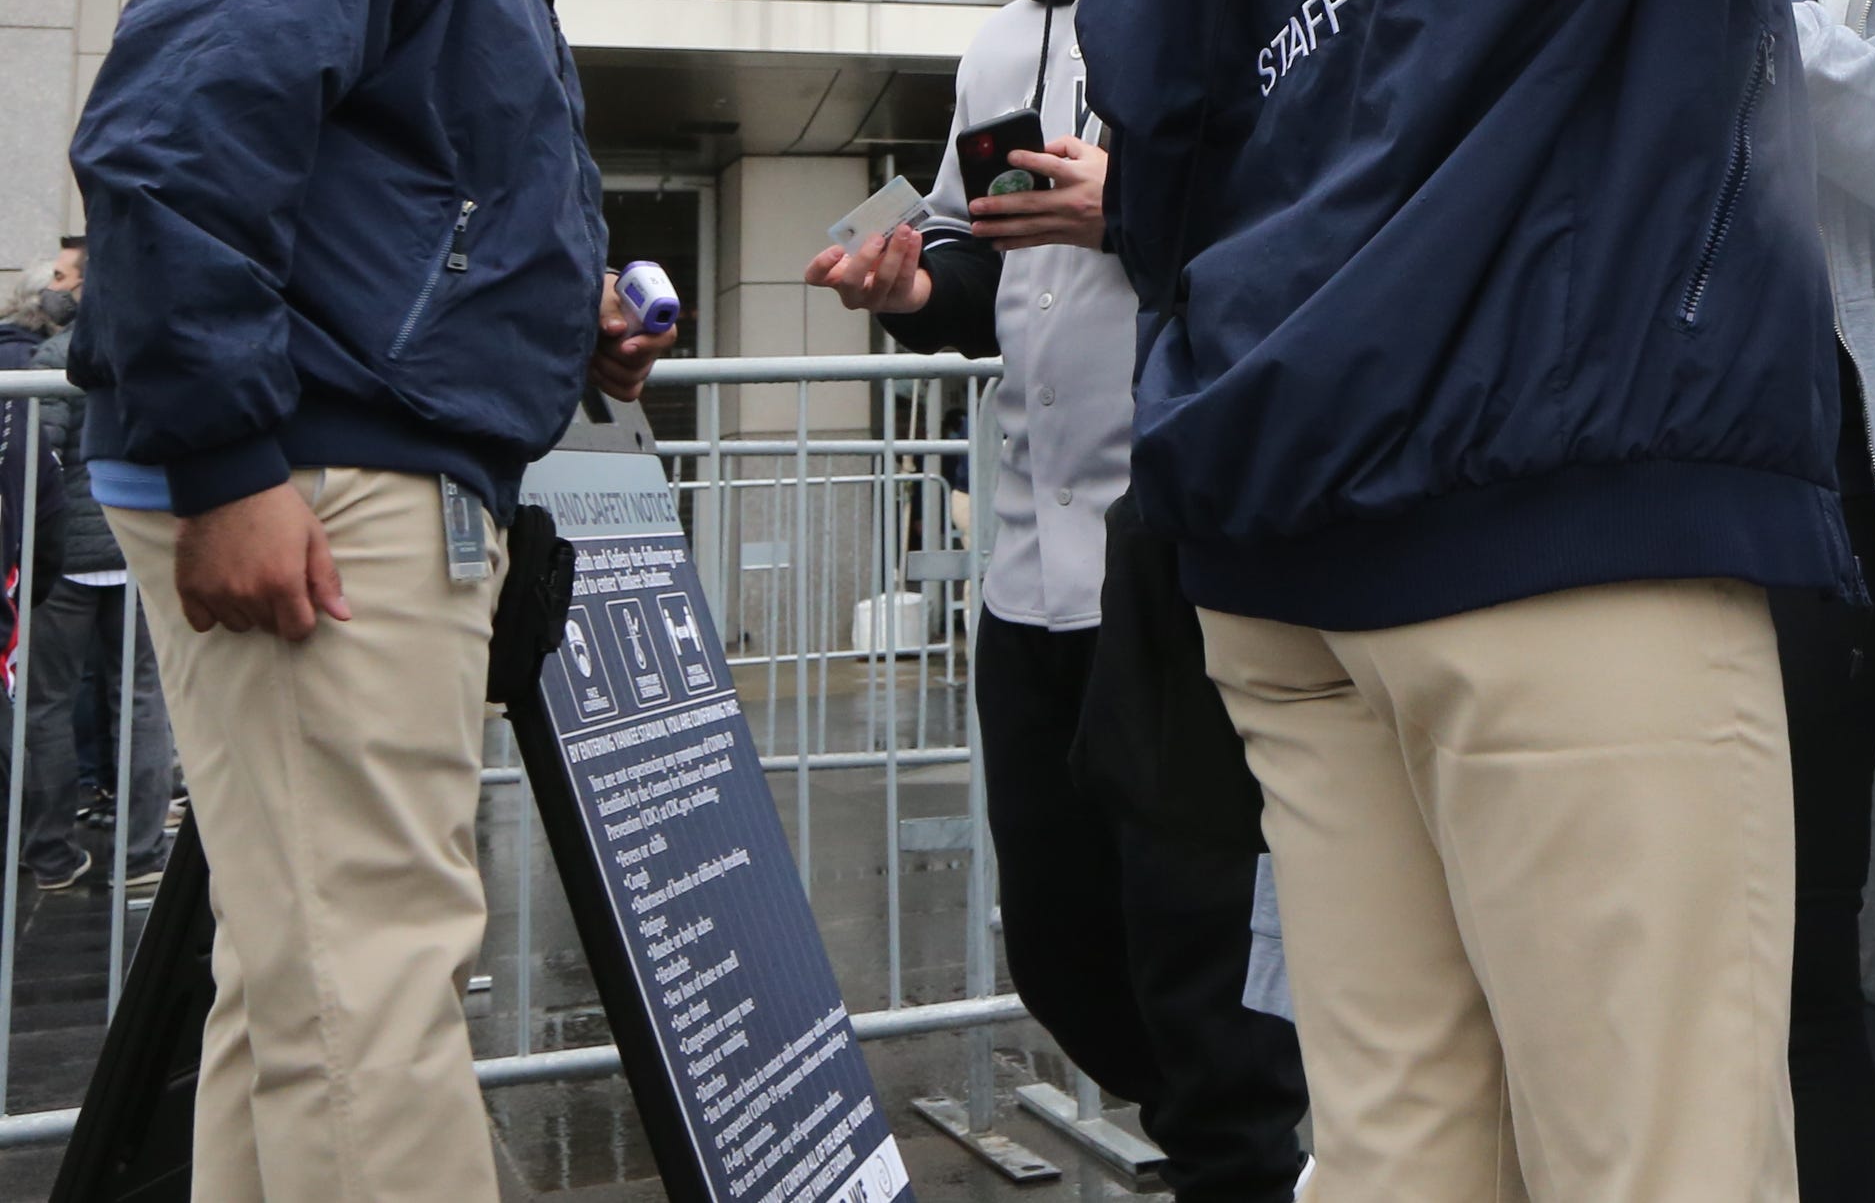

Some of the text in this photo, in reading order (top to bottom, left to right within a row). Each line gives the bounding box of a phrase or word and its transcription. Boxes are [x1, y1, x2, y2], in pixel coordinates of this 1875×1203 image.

[554, 492, 587, 526] AND
[585, 492, 632, 525] SAFETY
[629, 492, 676, 523] NOTICE
[574, 545, 687, 573] ealth and Safety the following are
[596, 575, 618, 593] enter
[614, 568, 643, 591] Yankee
[567, 743, 581, 763] BY
[578, 734, 615, 759] ENTERING
[611, 726, 642, 749] YANKEE
[636, 719, 669, 742] STADIUM,
[664, 715, 683, 733] YOU
[678, 712, 694, 730] ARE
[688, 703, 727, 726] CONFIRMING
[587, 731, 734, 792] You are not experiencing any symptoms of COVID-19
[596, 754, 732, 816] identified by the Centers for Disease Control and
[604, 815, 643, 841] Prevention
[639, 805, 662, 829] (CDC)
[659, 805, 669, 820] at
[640, 844, 650, 858] or
[649, 833, 667, 854] chills
[633, 848, 750, 914] Shortness of breath or difficulty breathing
[641, 915, 668, 937] Fatigue
[648, 916, 713, 961] Muscle or body aches
[657, 955, 690, 984] Headache
[664, 989, 683, 1008] New
[678, 981, 696, 999] loss
[699, 968, 717, 986] taste
[714, 963, 724, 978] or
[721, 950, 739, 973] smell
[673, 999, 710, 1032] Sore throat
[681, 997, 755, 1054] Congestion or runny nose
[689, 1053, 715, 1079] Nausea
[713, 1047, 723, 1063] or
[697, 1073, 727, 1102] Diarrhea
[704, 1105, 721, 1124] You
[716, 1094, 735, 1115] have
[732, 1084, 746, 1103] not
[740, 1075, 759, 1095] been
[754, 1067, 766, 1084] in
[722, 1106, 753, 1143] suspected
[749, 1085, 778, 1119] COVID-19
[722, 1147, 746, 1174] 14-day
[781, 1159, 811, 1195] CONFIRM
[805, 1150, 820, 1172] ALL
[815, 1141, 826, 1162] OF
[821, 1133, 837, 1155] THE
[847, 1106, 863, 1130] YOU
[857, 1095, 873, 1120] MUST
[730, 1178, 747, 1197] You
[744, 1169, 757, 1187] are
[753, 1159, 767, 1178] not
[809, 1163, 836, 1196] YANKEE
